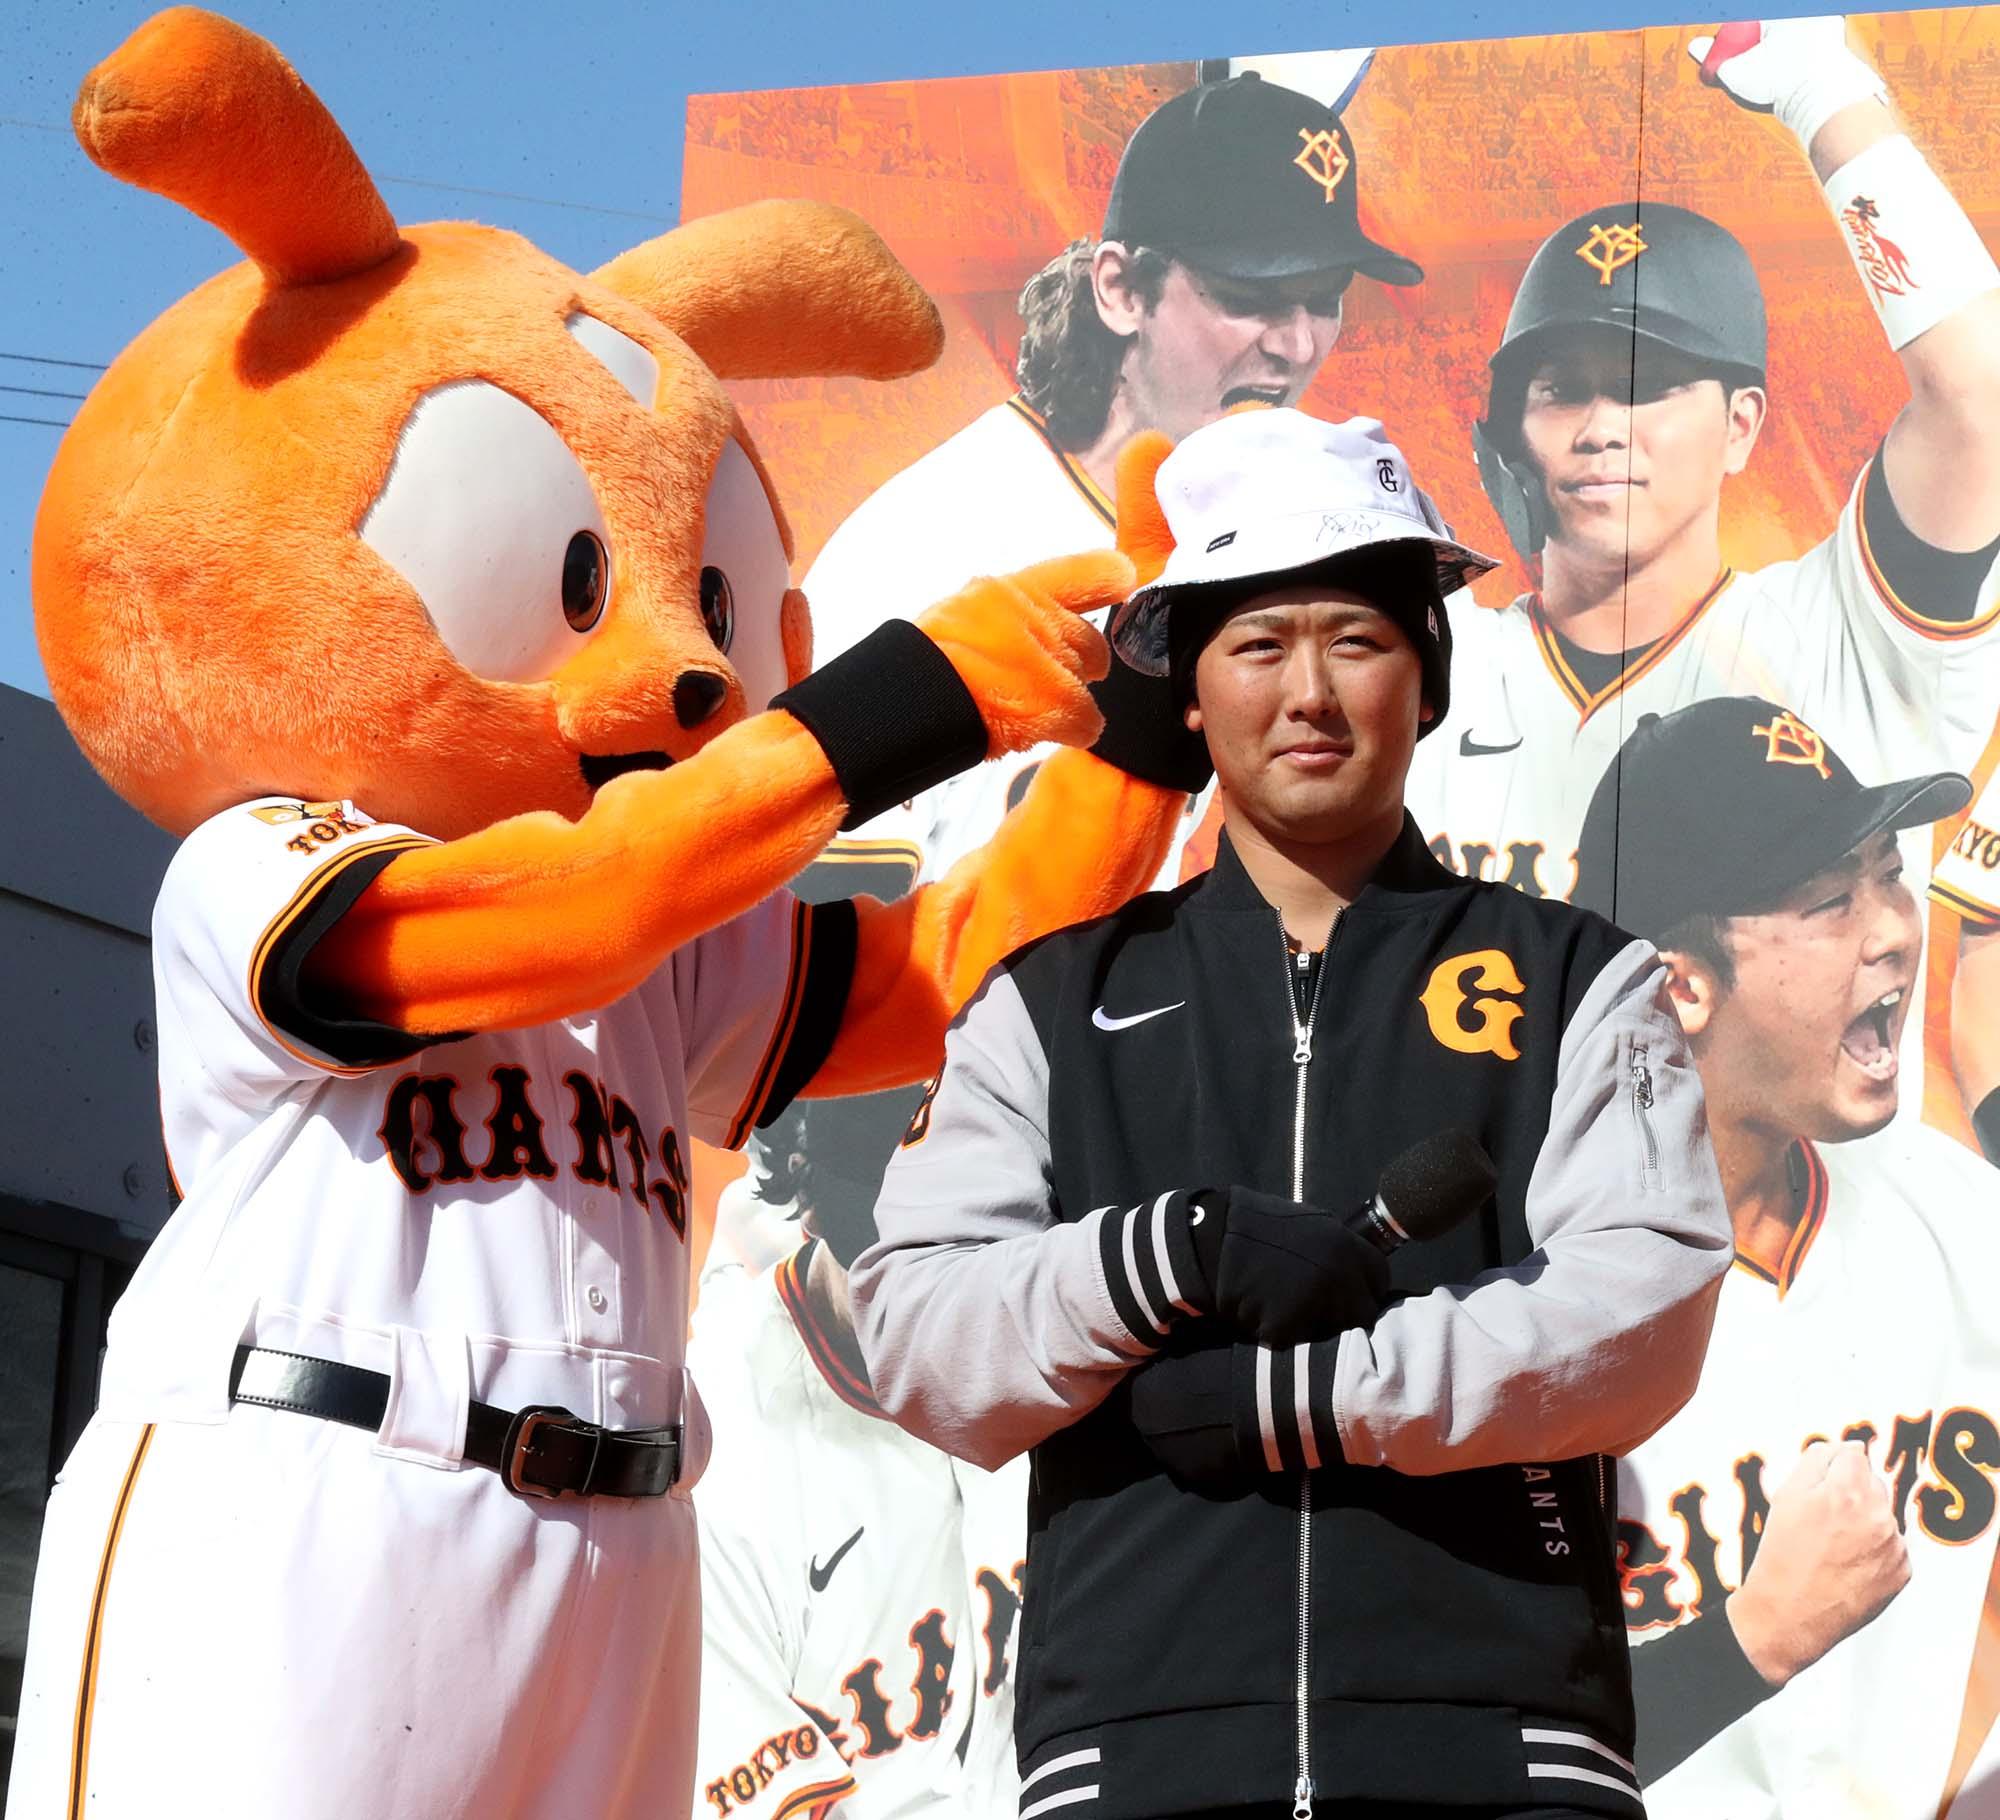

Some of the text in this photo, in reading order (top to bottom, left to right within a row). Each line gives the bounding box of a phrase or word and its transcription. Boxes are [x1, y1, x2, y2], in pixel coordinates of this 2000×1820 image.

[1418, 948, 1527, 1062] G
[1521, 1465, 1570, 1556] ANTS
[705, 1724, 820, 1818] TOKYO
